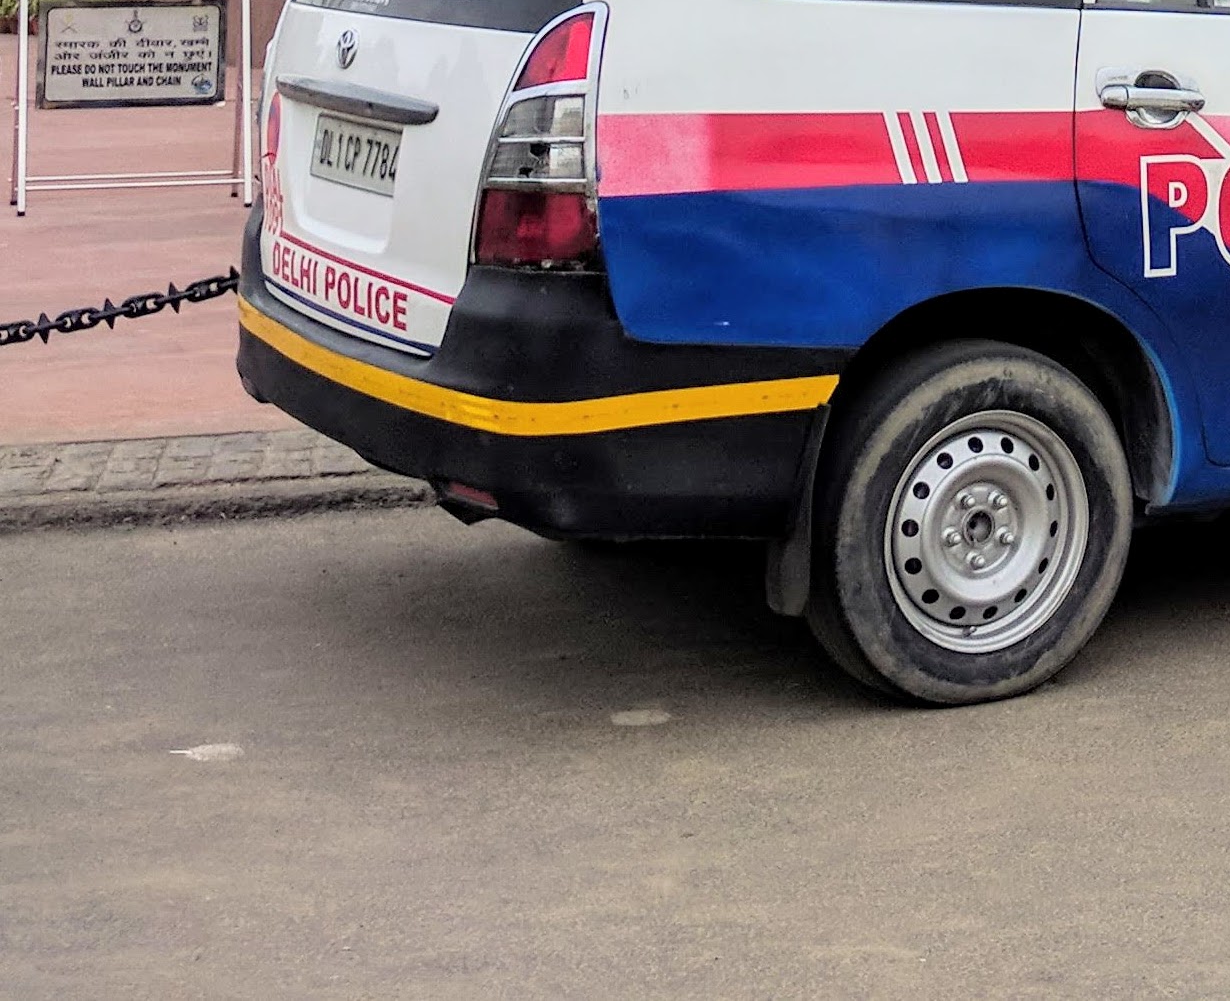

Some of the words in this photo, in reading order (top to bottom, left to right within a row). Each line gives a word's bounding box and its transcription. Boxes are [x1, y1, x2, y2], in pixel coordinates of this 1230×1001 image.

[110, 37, 126, 48] की
[51, 64, 82, 75] PLEASE
[84, 64, 96, 74] DO
[98, 63, 115, 74] NOT
[117, 63, 145, 74] TOUCH
[148, 62, 163, 73] THE
[166, 61, 212, 73] MONUMENT
[82, 78, 104, 88] WALL
[107, 76, 135, 87] PILLAR
[136, 76, 153, 86] AND
[156, 75, 181, 86] CHAIN
[272, 240, 318, 296] DELHI
[325, 265, 408, 332] POLICE
